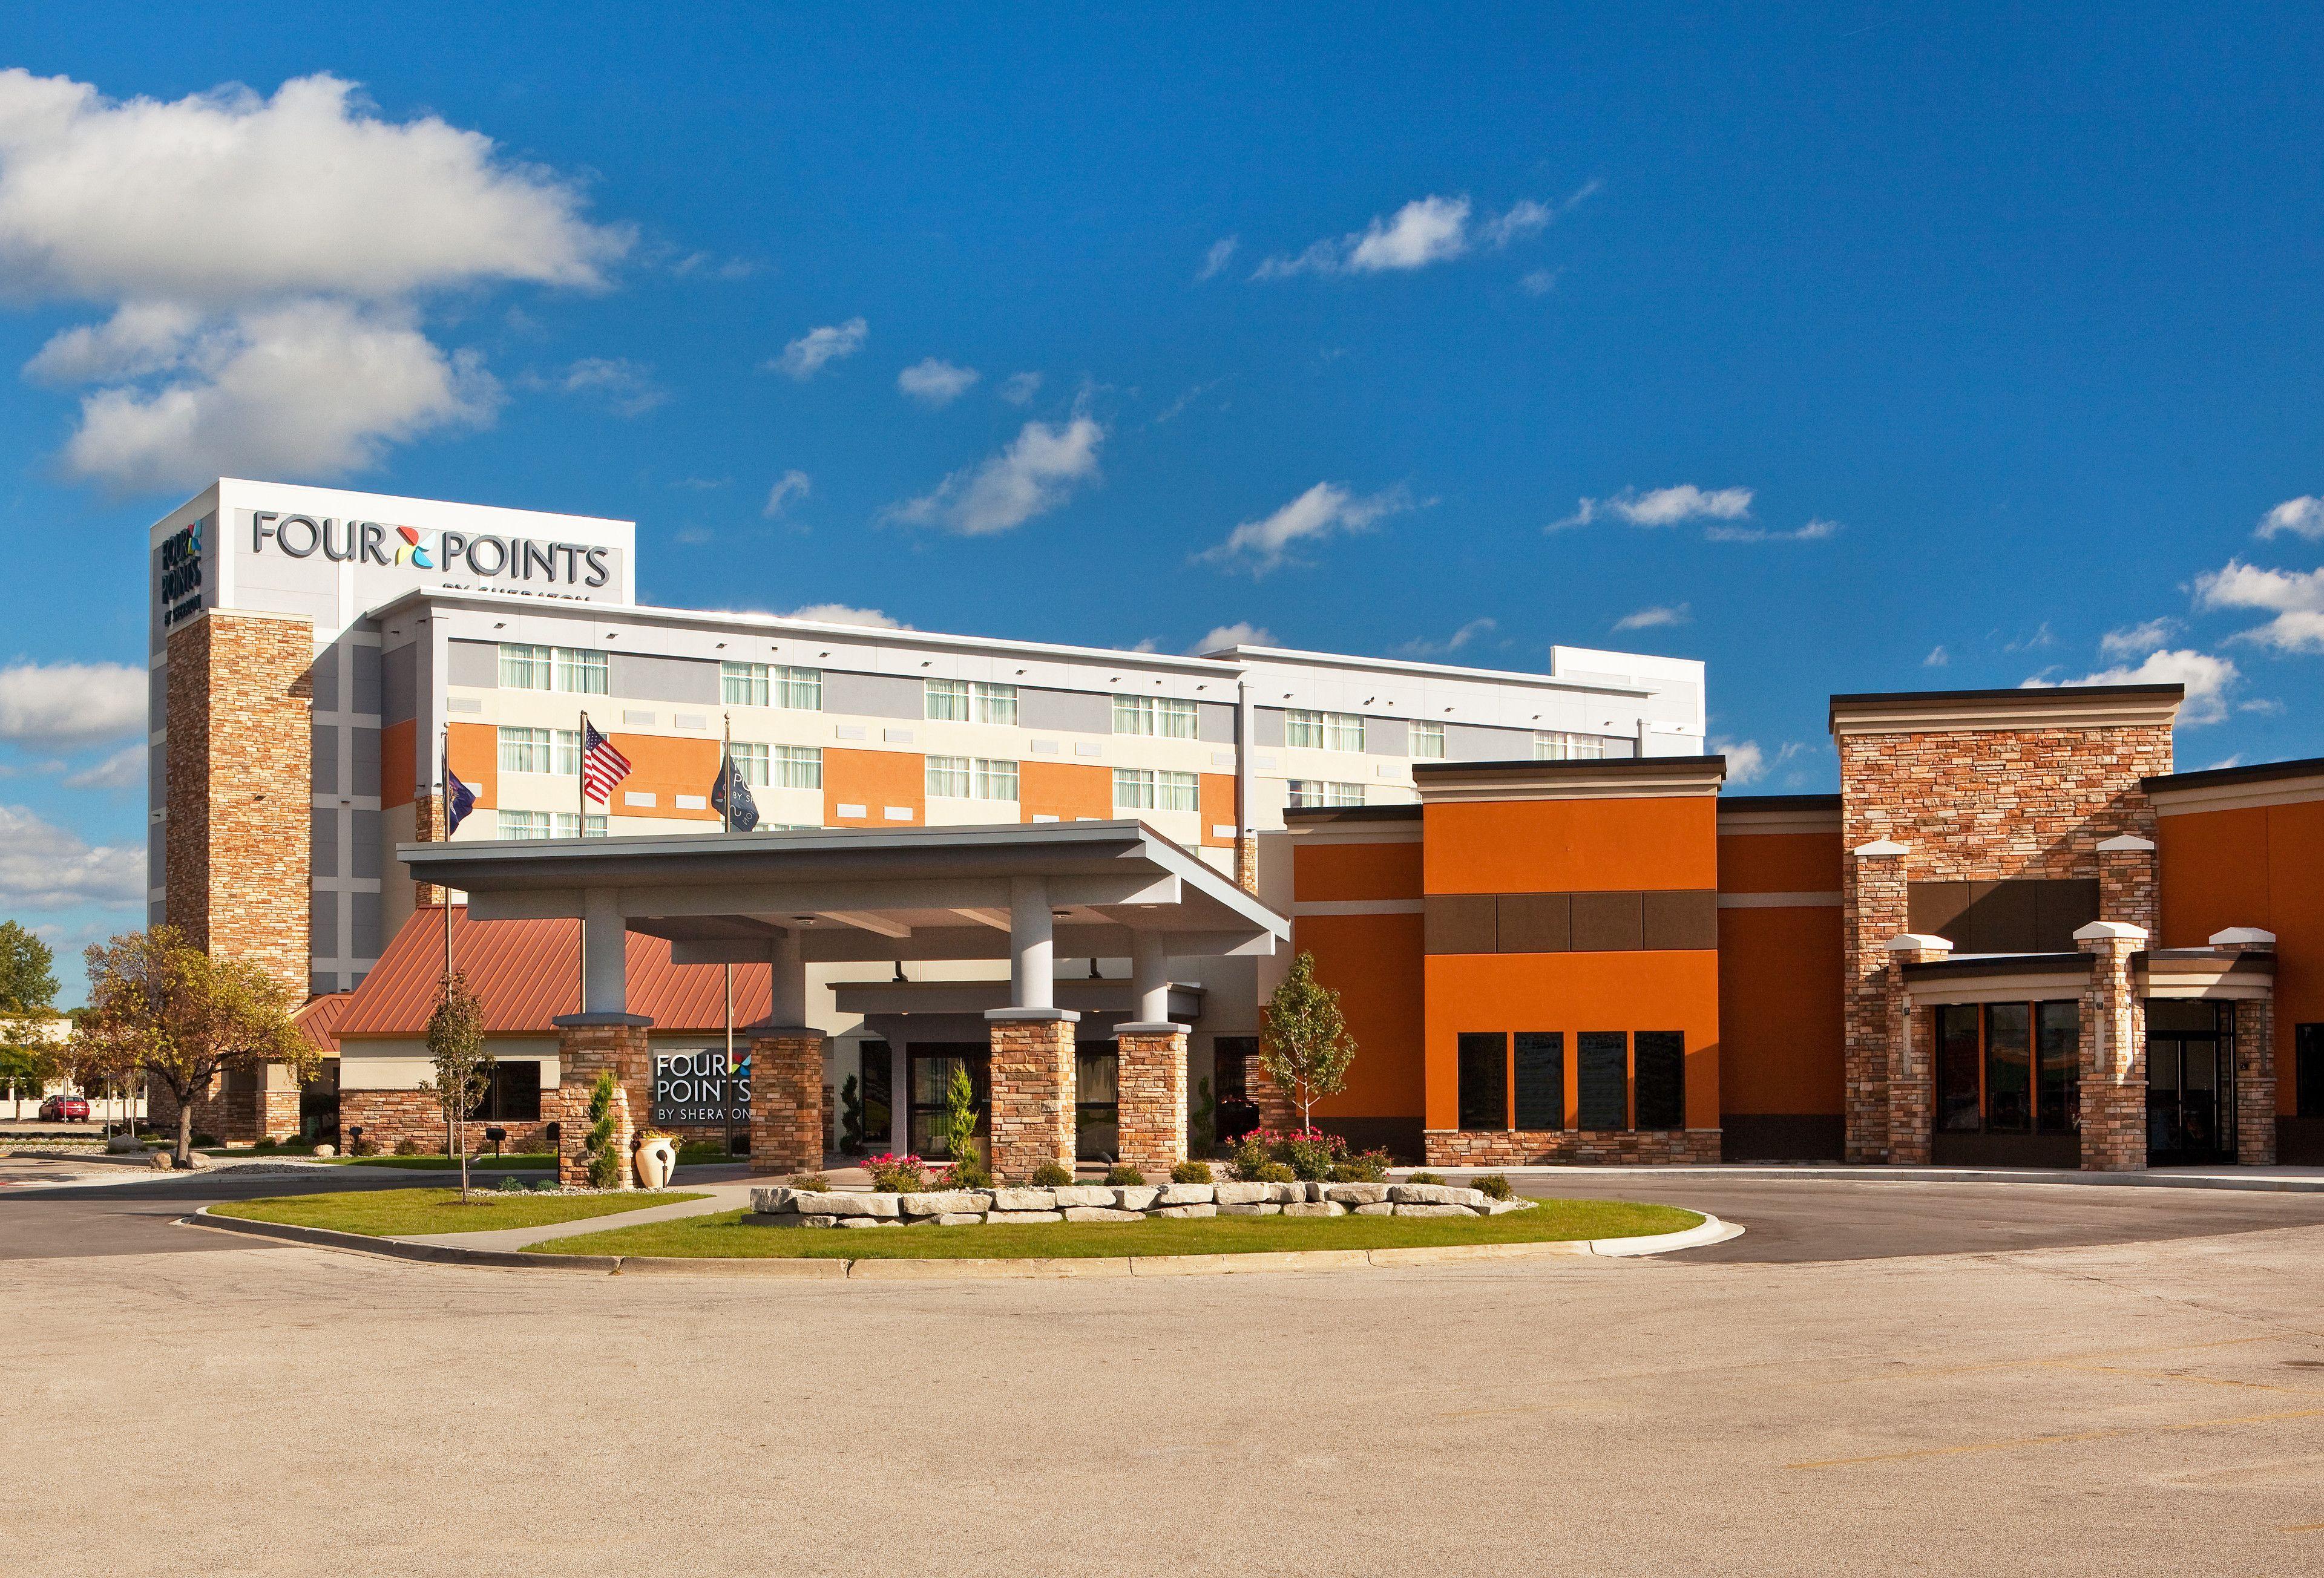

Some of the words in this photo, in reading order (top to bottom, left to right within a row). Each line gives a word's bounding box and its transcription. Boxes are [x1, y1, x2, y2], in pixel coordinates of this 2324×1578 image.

[254, 511, 392, 566] FOUR
[442, 532, 610, 588] POINTS
[733, 791, 743, 800] BY
[657, 1054, 726, 1077] FOUR
[658, 1108, 674, 1120] BY
[680, 1108, 751, 1120] SHERAON
